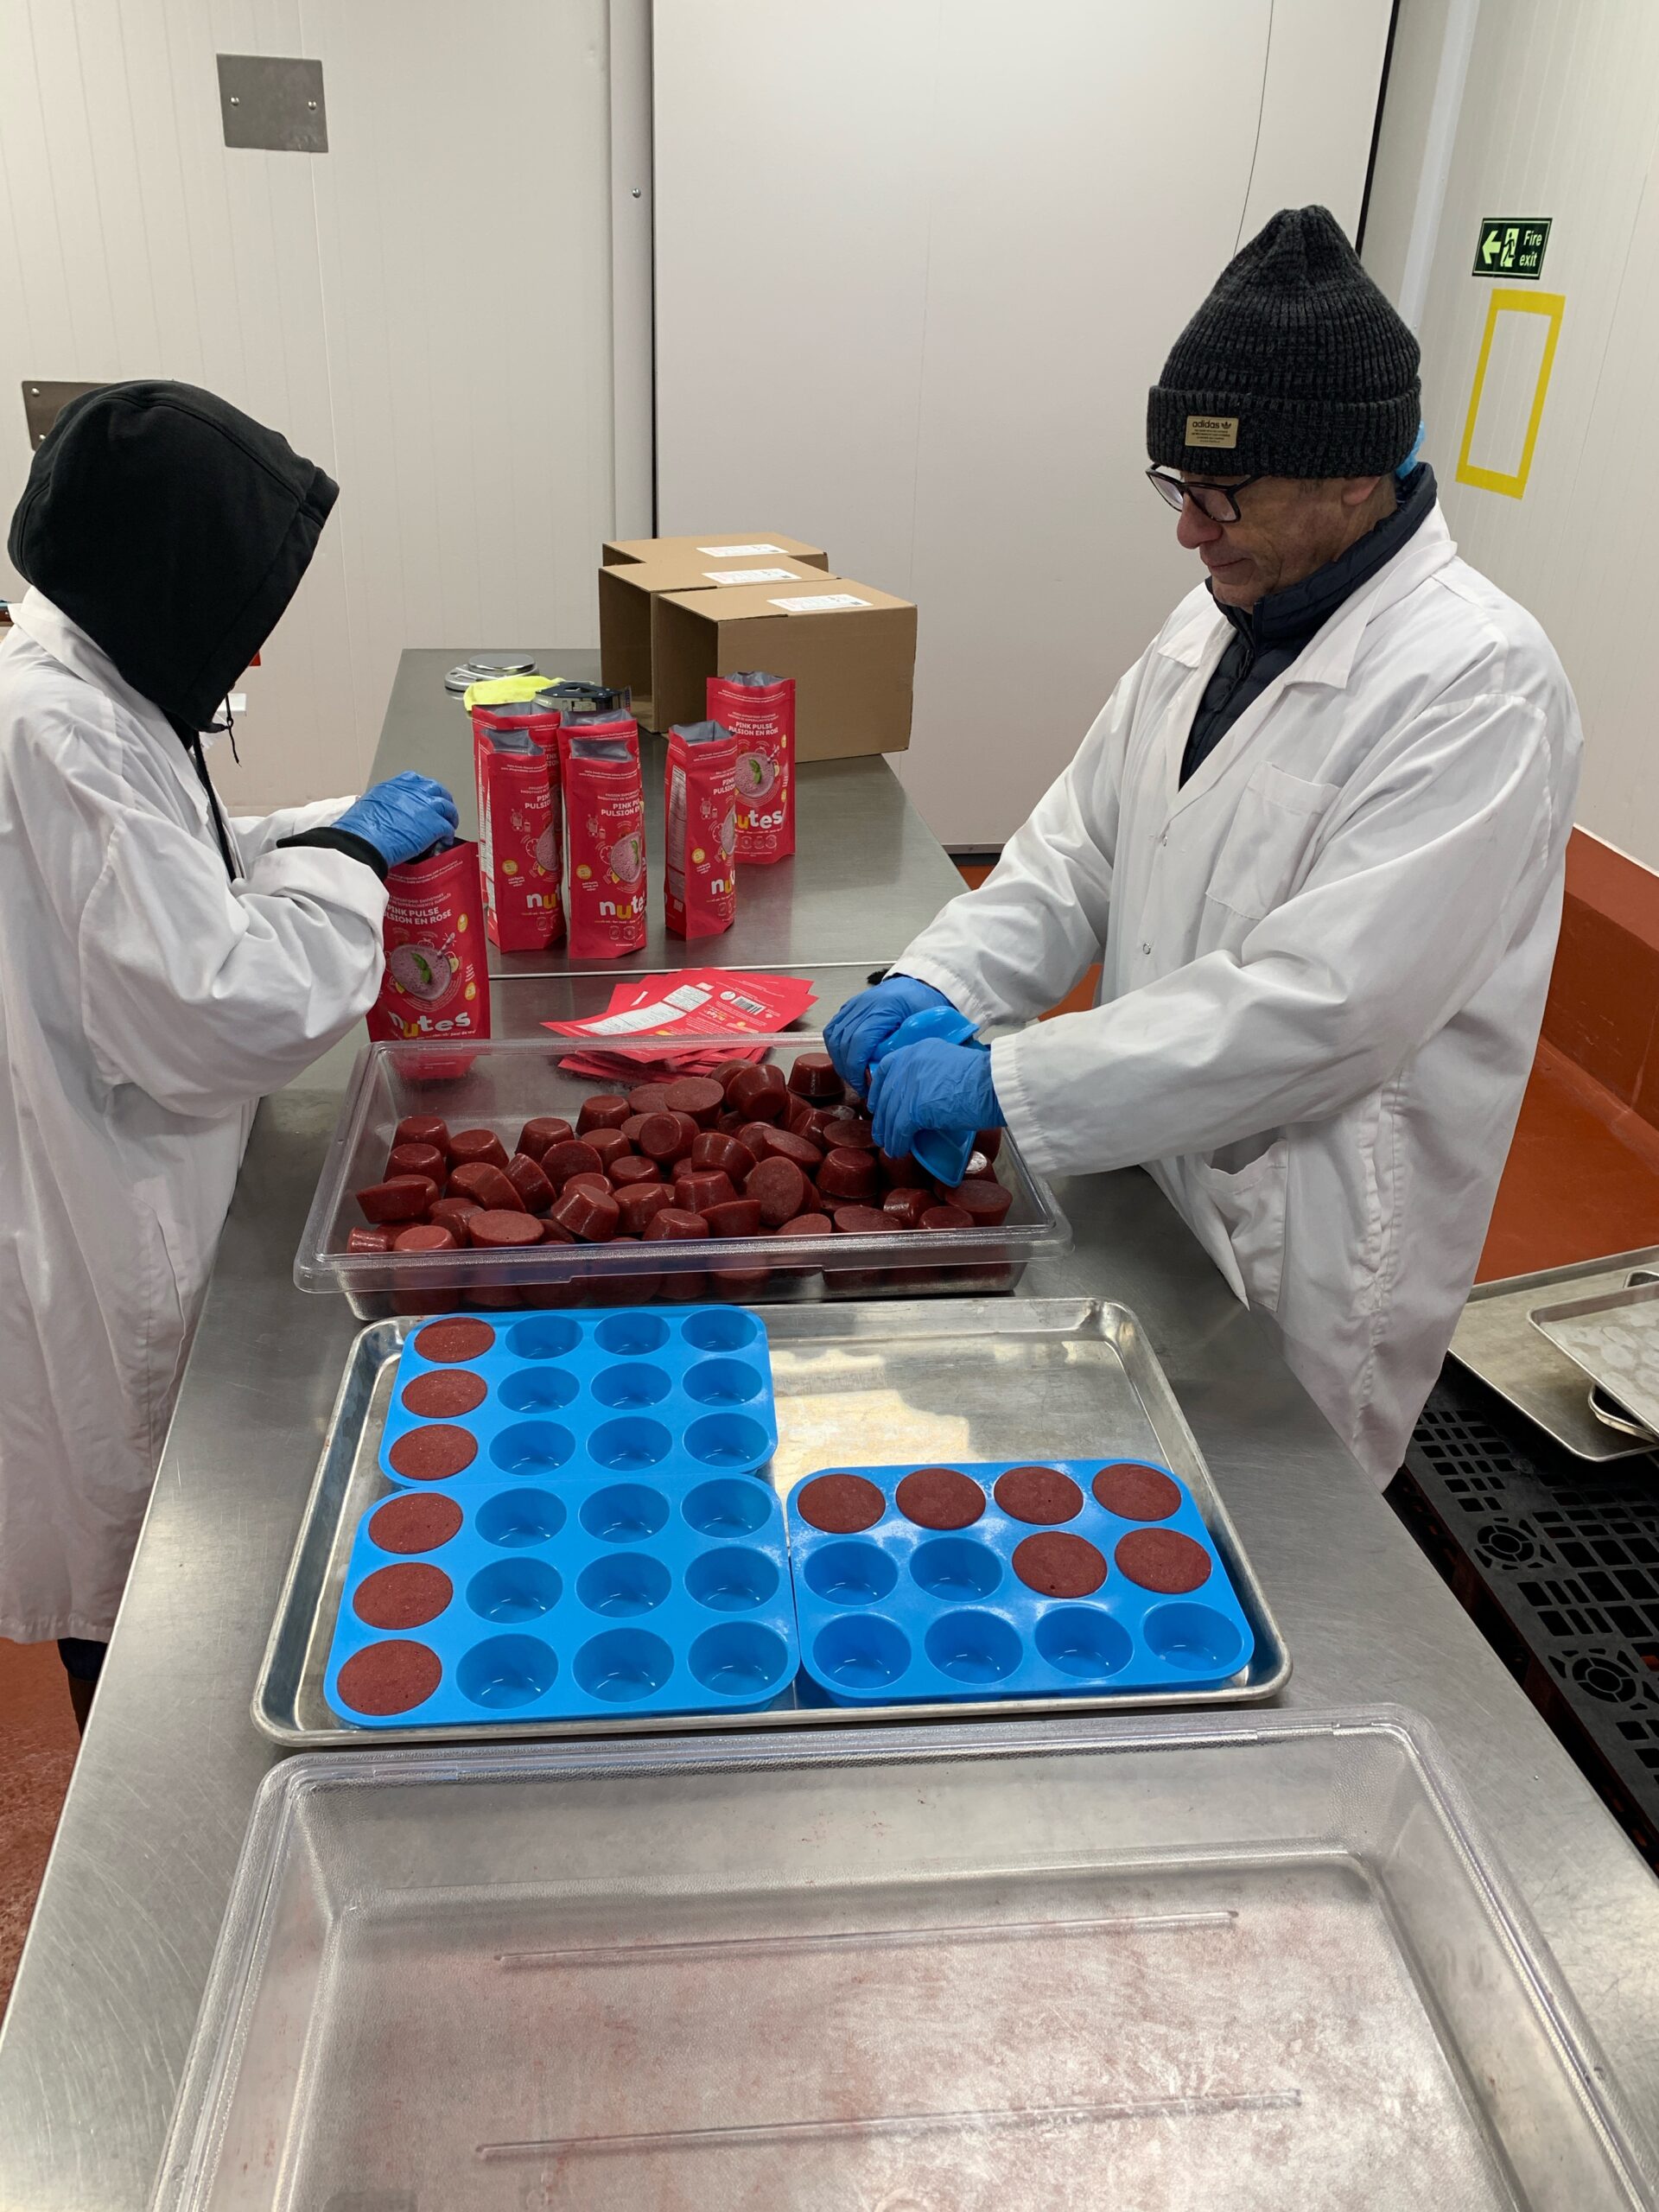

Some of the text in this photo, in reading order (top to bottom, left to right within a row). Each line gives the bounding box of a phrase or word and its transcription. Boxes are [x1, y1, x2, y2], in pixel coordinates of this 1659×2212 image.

[1523, 230, 1542, 246] Fire
[1519, 251, 1537, 267] exit
[1192, 419, 1220, 429] adidas
[524, 799, 551, 810] PULSIO
[601, 807, 635, 817] PULSION
[613, 802, 632, 810] PINK
[735, 810, 783, 830] utes
[386, 905, 440, 918] PINK PULSE
[599, 891, 645, 919] nute
[429, 909, 452, 924] ROSE
[387, 1012, 471, 1038] nutes
